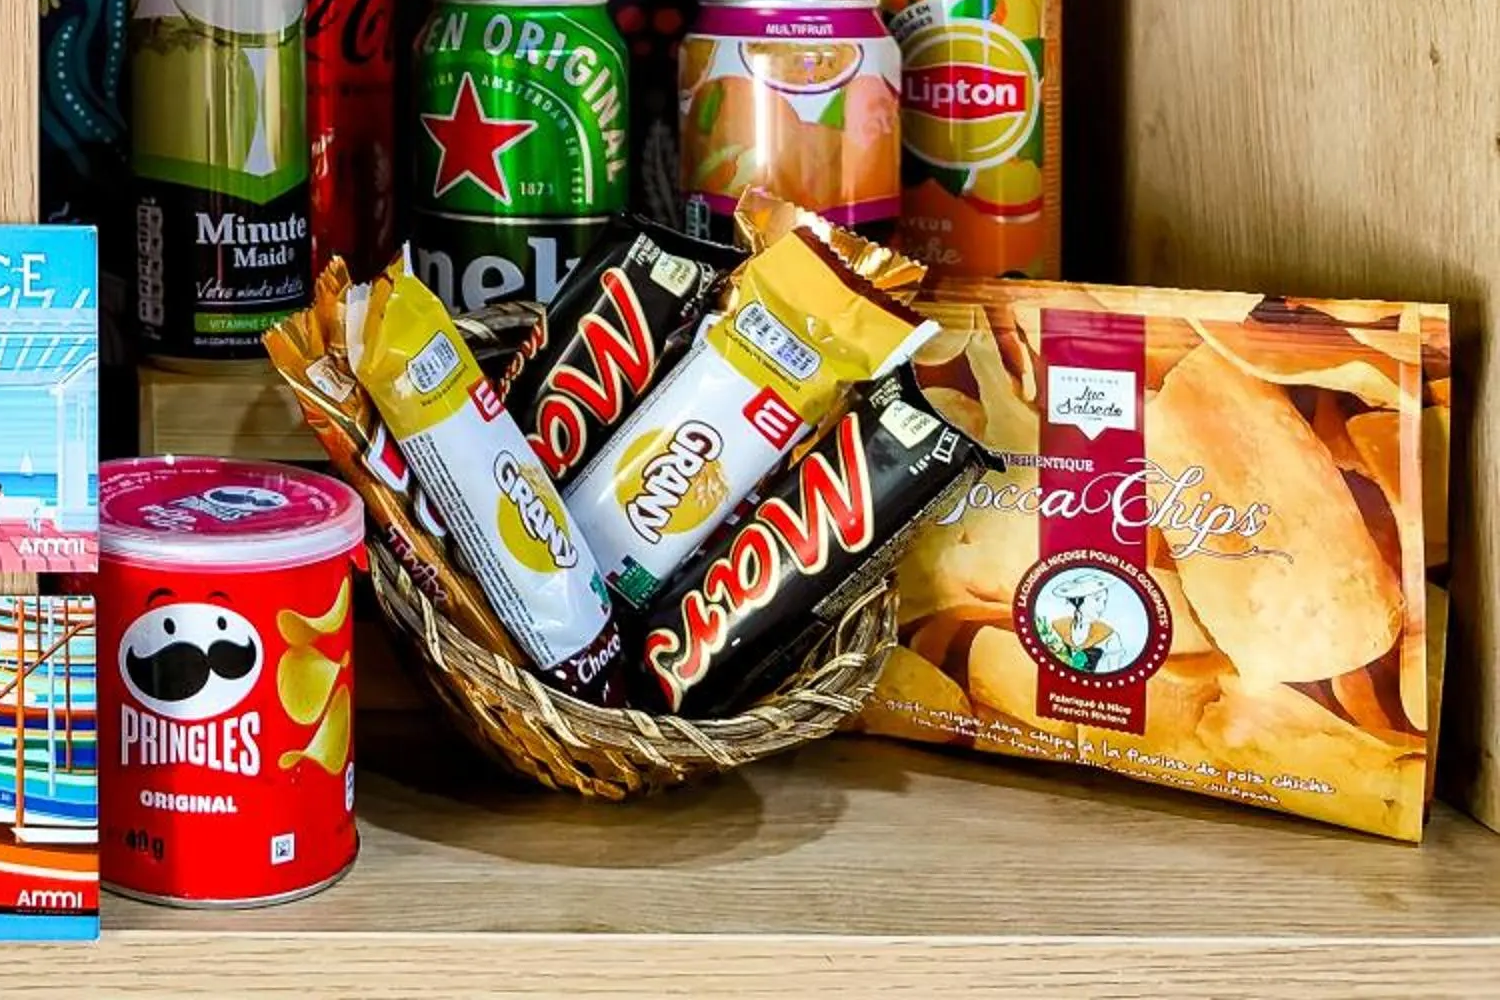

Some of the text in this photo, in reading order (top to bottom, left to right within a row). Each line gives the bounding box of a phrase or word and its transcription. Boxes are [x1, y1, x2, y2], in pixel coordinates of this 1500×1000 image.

[765, 23, 833, 36] MULTIFRUIT
[483, 12, 625, 183] ORIGINAL
[907, 76, 1017, 109] Lipton
[195, 212, 307, 245] Minute
[752, 396, 797, 441] LU
[624, 419, 724, 545] GRANY
[493, 450, 579, 569] GRANY
[1088, 457, 1268, 561] Chips
[644, 412, 874, 712] Mars
[1089, 550, 1119, 567] POUR
[577, 633, 621, 684] Choco
[120, 702, 261, 777] PRINGLES
[1102, 740, 1121, 759] la
[140, 789, 238, 814] ORIGINAL
